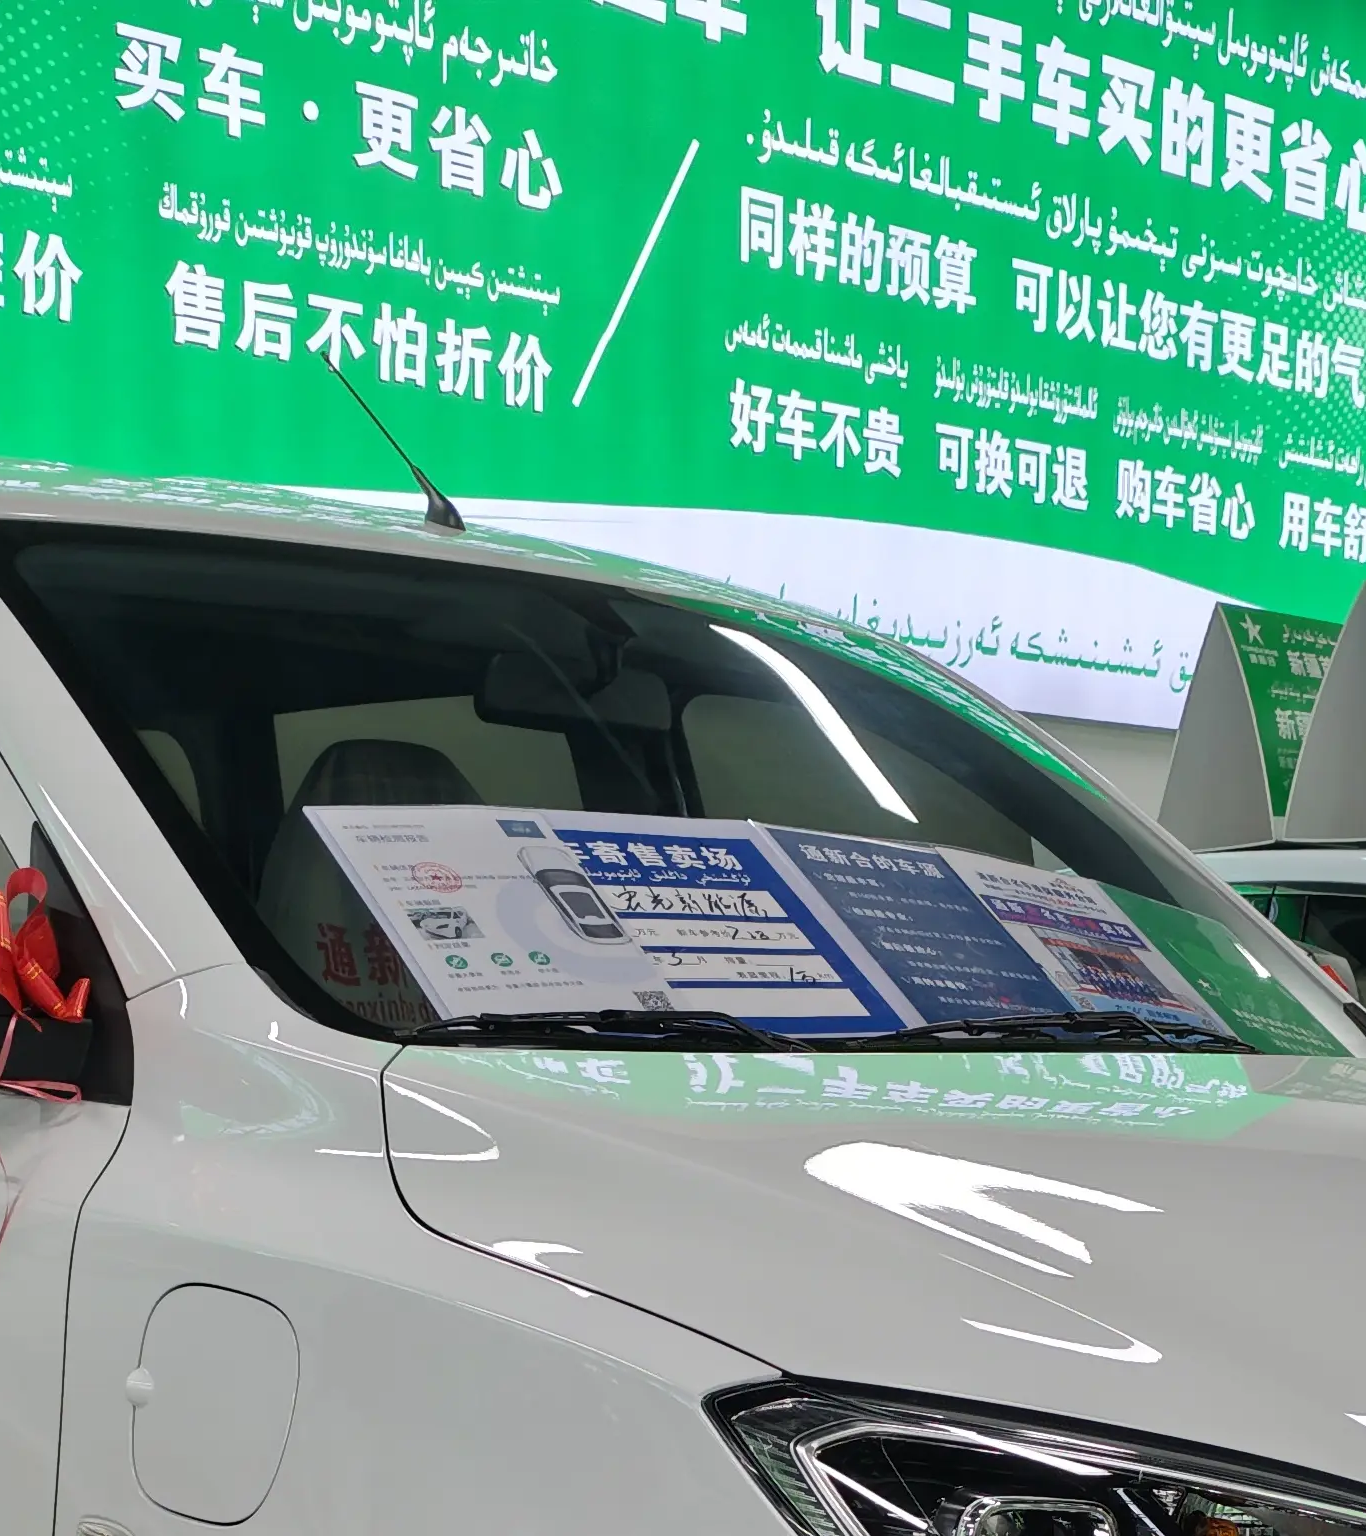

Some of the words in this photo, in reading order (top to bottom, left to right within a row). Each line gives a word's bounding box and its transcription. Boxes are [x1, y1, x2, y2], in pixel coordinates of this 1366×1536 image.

[739, 185, 978, 315] 同样的预算
[165, 261, 552, 412] 售后不怕折价
[728, 378, 904, 478] 好车不贵
[935, 423, 1090, 511] 可换可退
[1115, 458, 1256, 540] 购车省心
